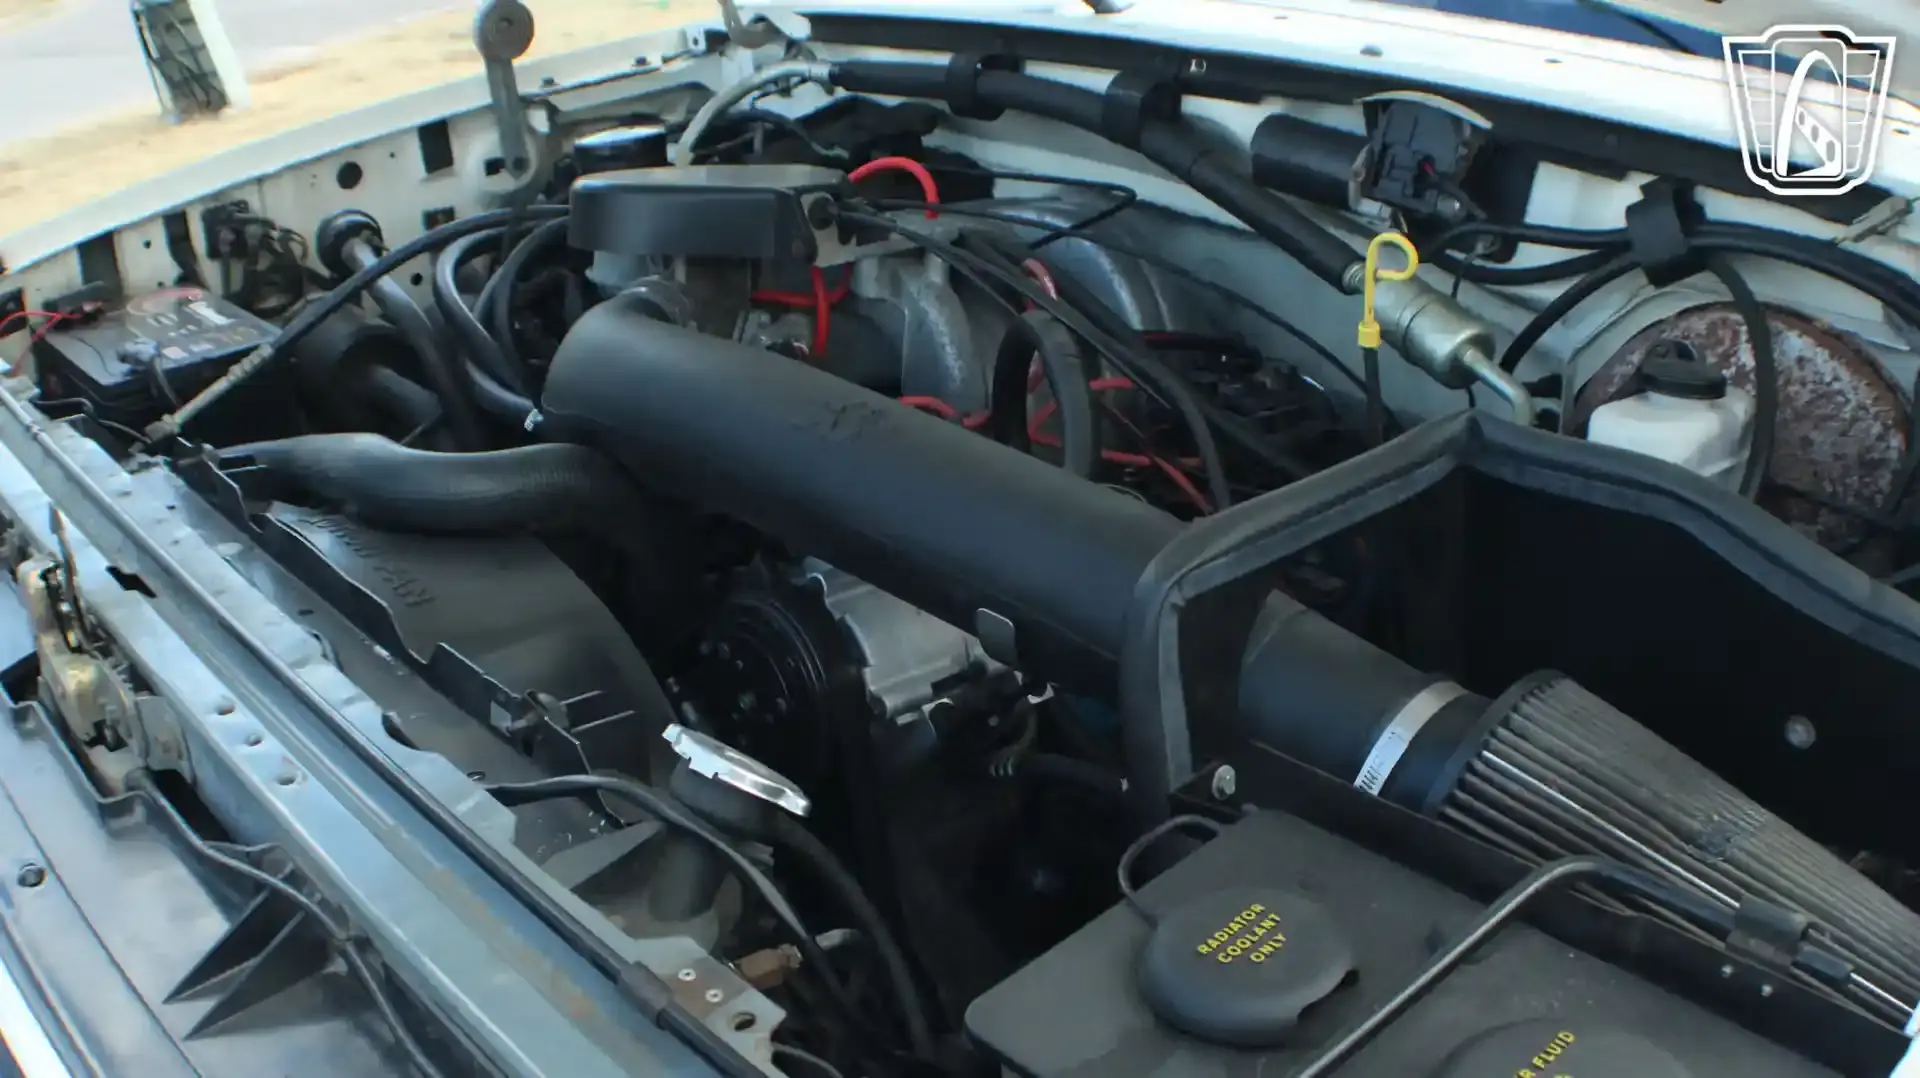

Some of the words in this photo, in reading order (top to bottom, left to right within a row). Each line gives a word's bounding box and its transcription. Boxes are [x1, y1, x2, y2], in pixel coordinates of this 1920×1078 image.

[1197, 903, 1266, 954] RADIATOR
[1217, 912, 1281, 963] COOLANT
[1249, 932, 1287, 962] ONLY
[1531, 1031, 1575, 1069] FLUID
